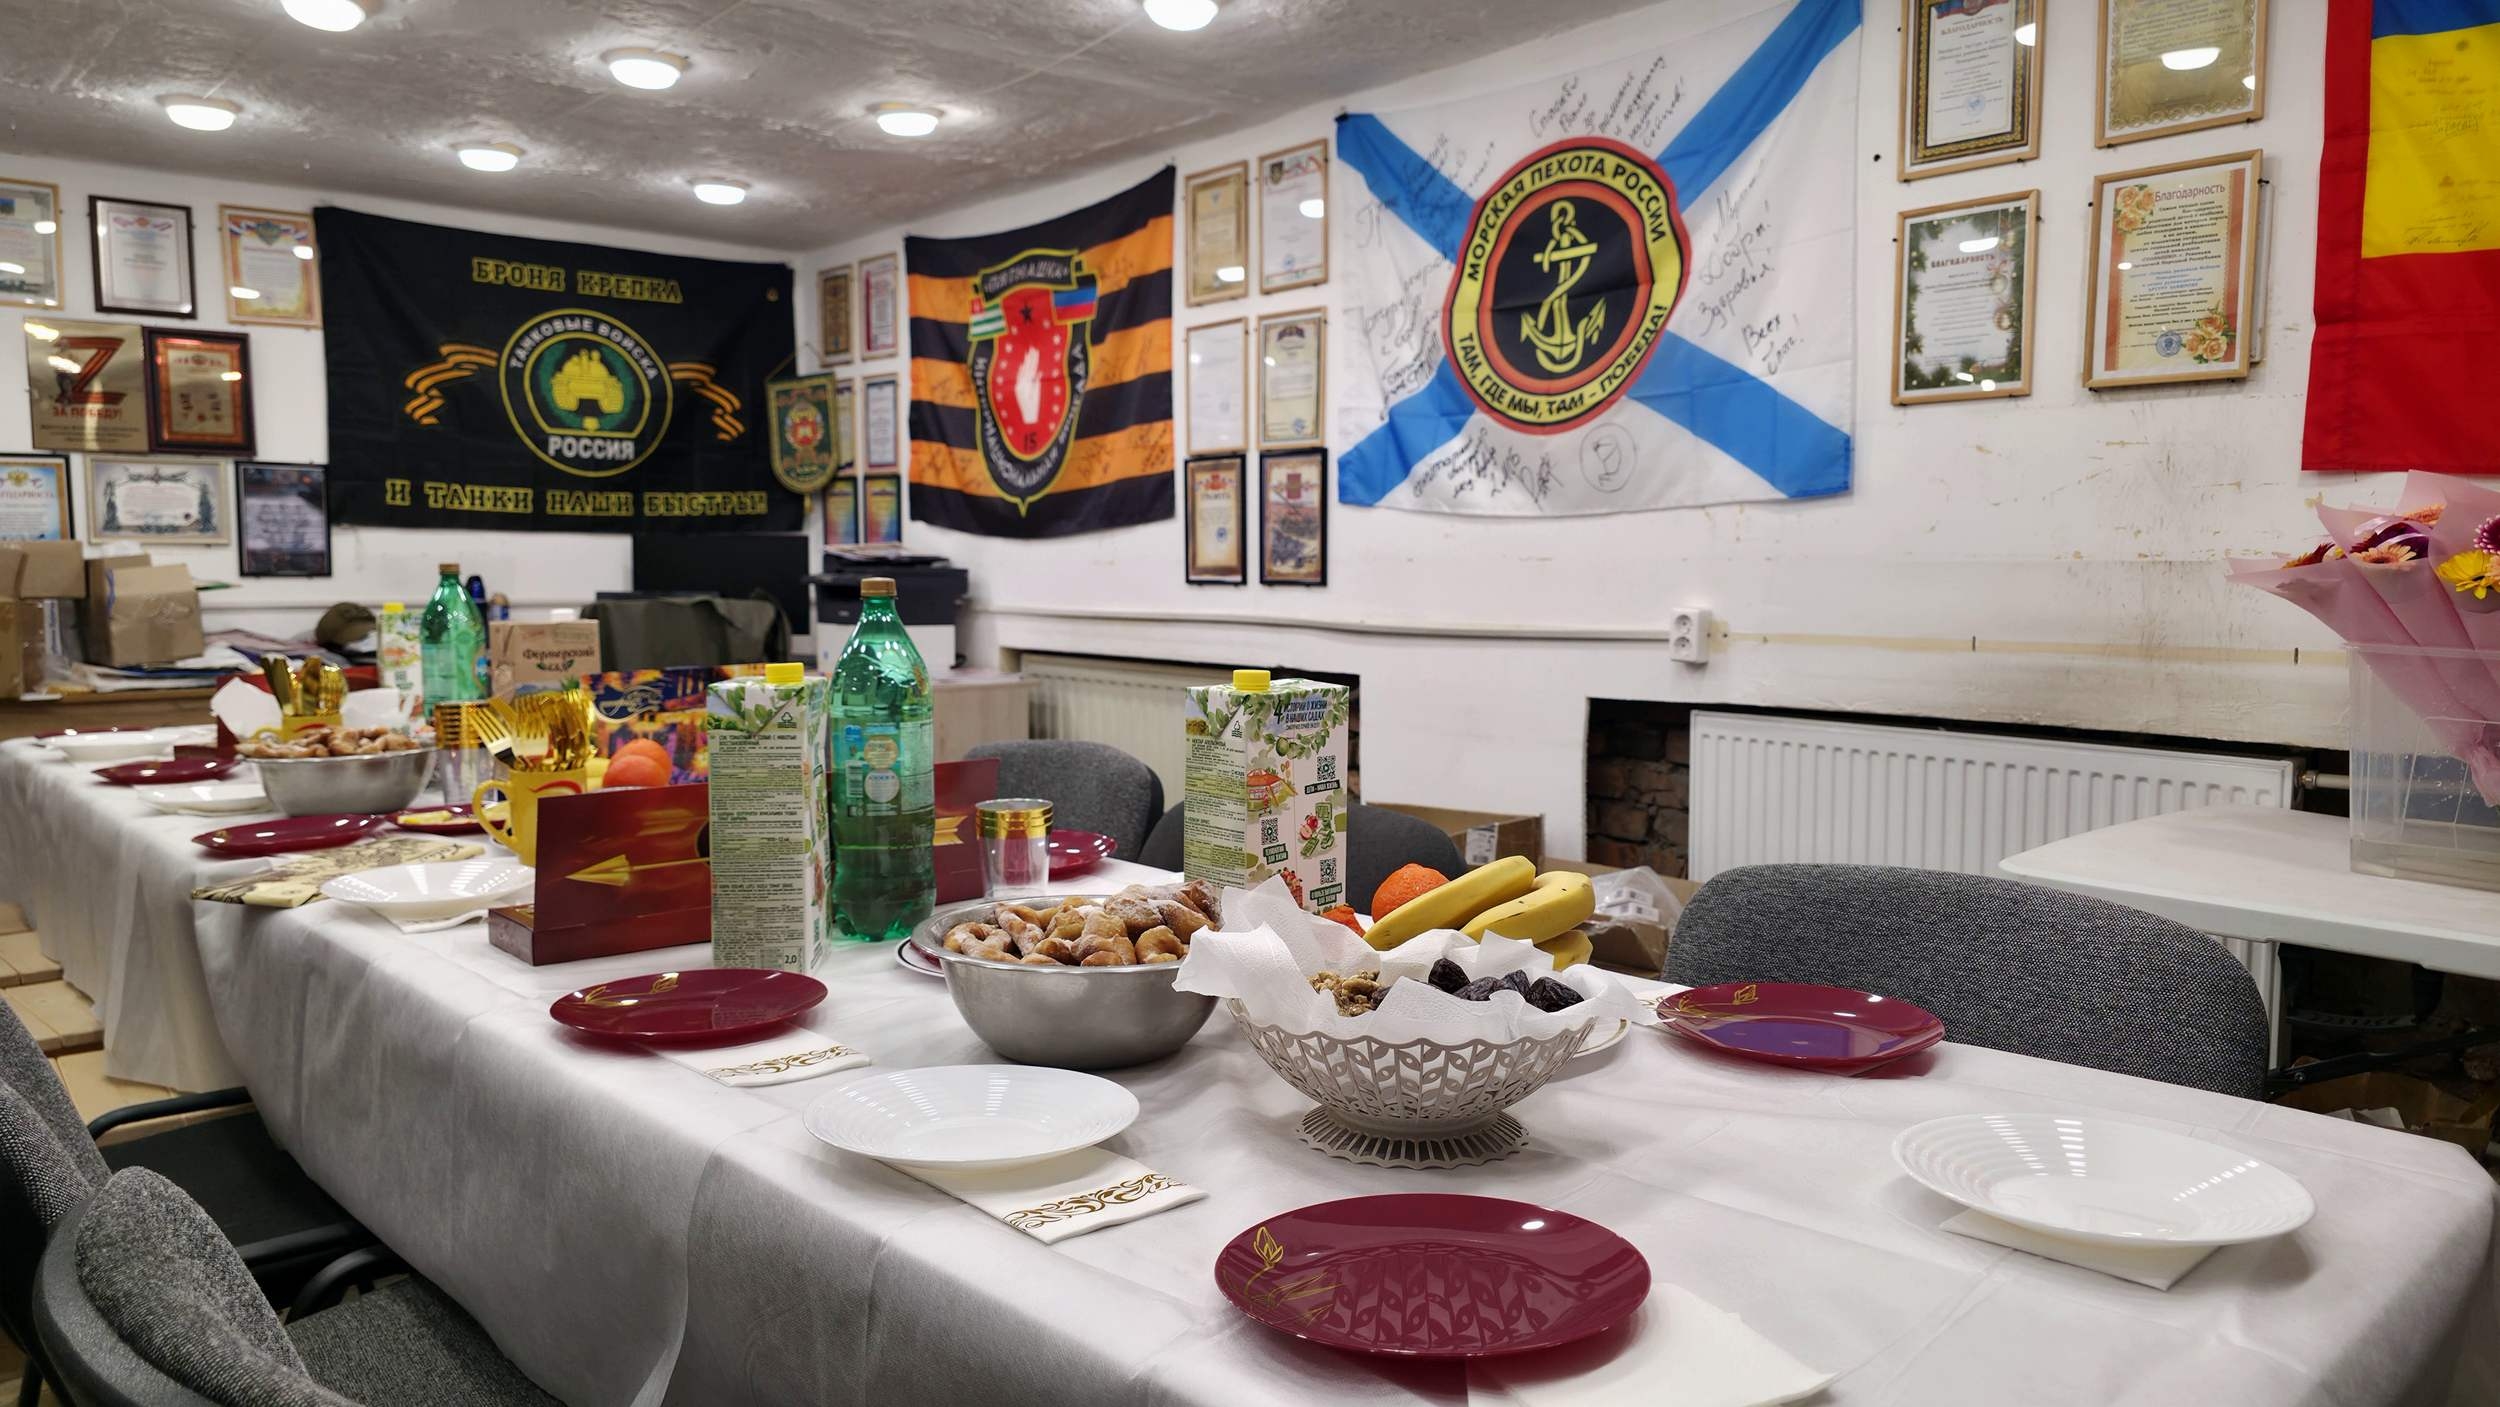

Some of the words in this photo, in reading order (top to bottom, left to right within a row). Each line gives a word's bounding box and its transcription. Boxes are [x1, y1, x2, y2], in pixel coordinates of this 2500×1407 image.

[2154, 184, 2226, 201] Благодарность
[1468, 179, 1525, 281] МОРСКАЯ
[1530, 155, 1606, 187] ПЕХОТА
[1612, 163, 1667, 243] РОССИИ
[472, 256, 566, 293] БРОНЯ
[576, 270, 684, 304] КРЕПКА
[510, 317, 594, 369] ТАНКОВЫЕ
[597, 322, 660, 380] ВОЙСКА
[1459, 332, 1480, 381] ТАМ,
[1479, 372, 1504, 404] ГДЕ
[1507, 397, 1542, 419] МЫ,
[1546, 396, 1584, 416] ТАМ
[1600, 304, 1668, 393] ПОБЕДА!
[54, 337, 126, 404] Z
[53, 406, 70, 418] ЗА
[71, 407, 123, 420] ПОБЕДУ!
[548, 436, 636, 461] РОССИЯ
[1024, 432, 1038, 451] 15
[385, 478, 412, 507] И
[423, 481, 534, 514] ТАНКИ
[545, 489, 635, 517] НАШИ
[1273, 694, 1283, 725] 4
[784, 954, 798, 966] 2,0
